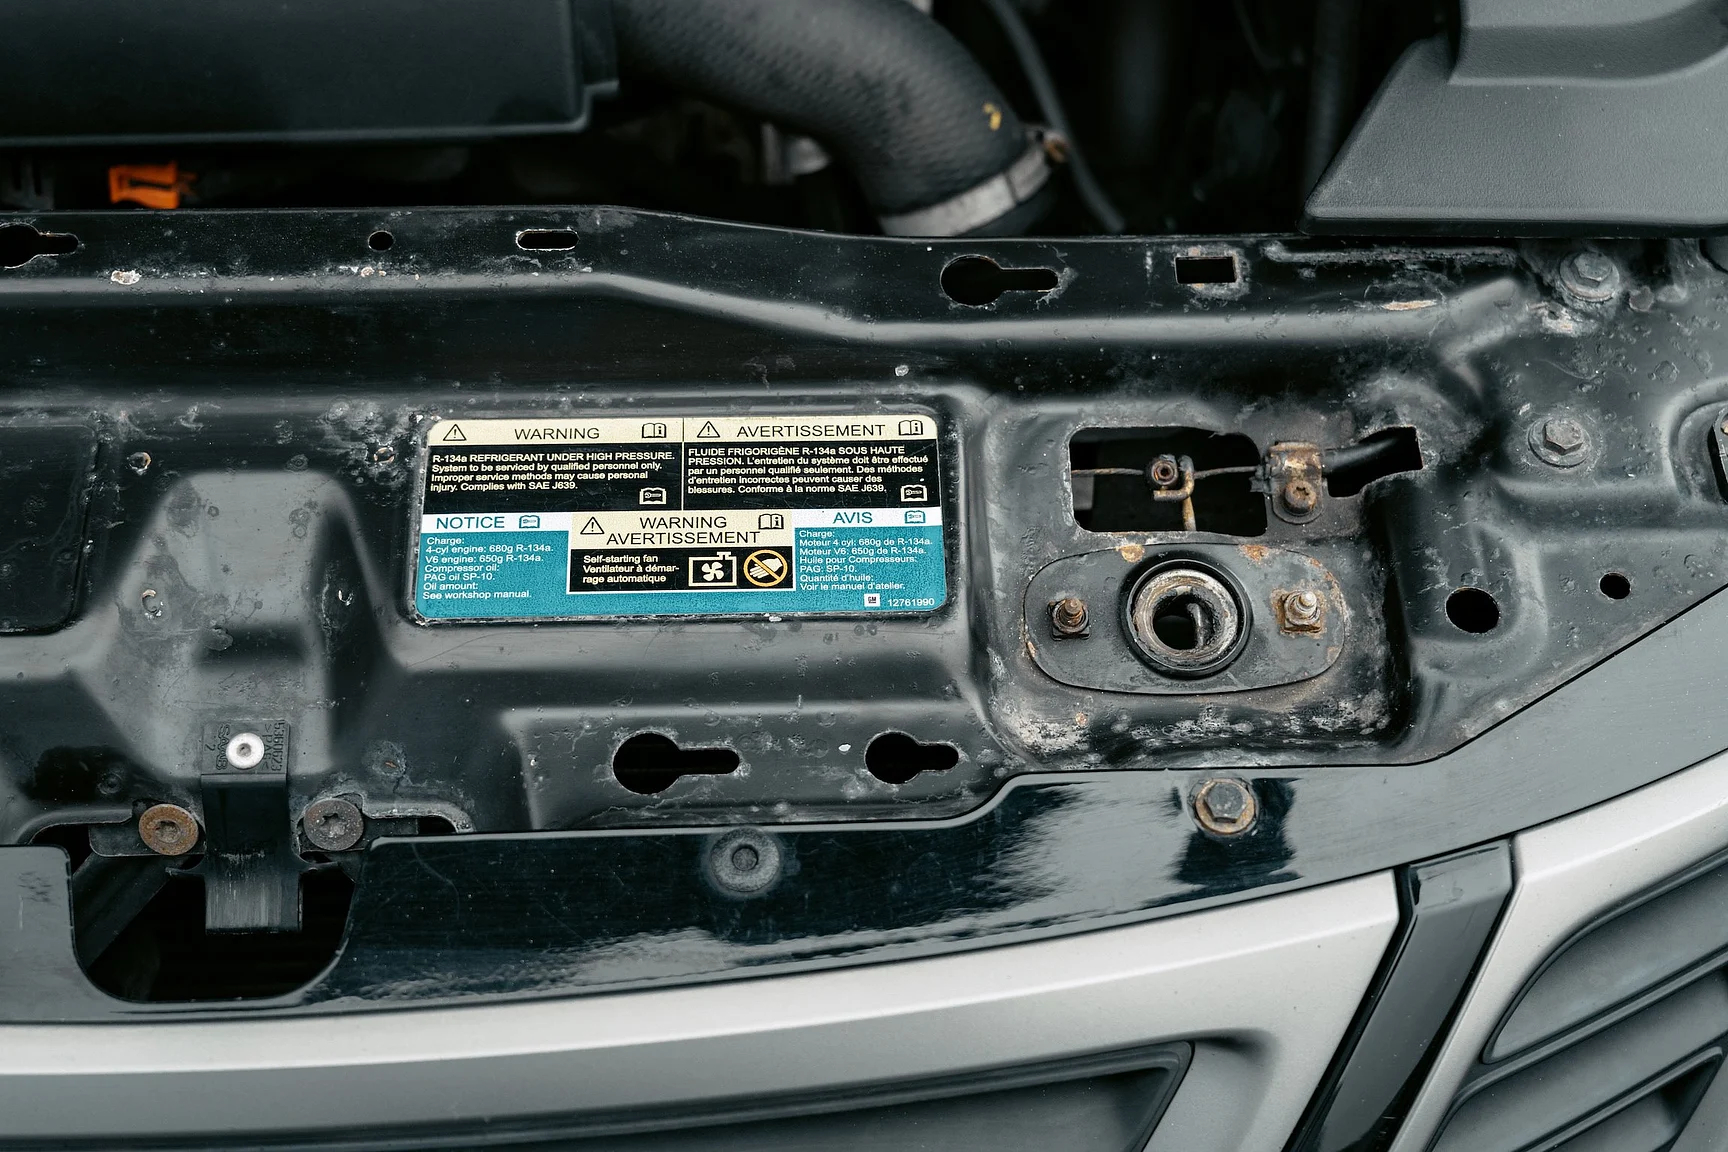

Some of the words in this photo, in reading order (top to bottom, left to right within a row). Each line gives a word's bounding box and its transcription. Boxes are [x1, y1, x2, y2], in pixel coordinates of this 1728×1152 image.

[515, 428, 600, 440] WARNING
[737, 425, 885, 437] AVERTISSEMENT
[689, 448, 726, 457] FLUIDE
[728, 446, 800, 456] FRIGORIGÈNE
[802, 447, 836, 455] R-134a
[838, 446, 868, 454] SOUS
[870, 446, 905, 454] HAUTE
[433, 454, 467, 463] R-134a
[470, 453, 544, 462] REFRIGERANT
[547, 453, 584, 461] UNDER
[586, 452, 612, 460] HIGH
[615, 452, 675, 460] PRESSURE.
[688, 457, 745, 466] PRESSION.
[747, 456, 794, 465] L'entretien
[797, 456, 808, 464] du
[811, 456, 850, 466] système
[852, 456, 869, 464] doit
[872, 455, 889, 464] être
[892, 455, 928, 463] effectué
[432, 464, 467, 473] System
[480, 463, 493, 471] be
[495, 463, 534, 472] serviced
[537, 462, 549, 472] by
[551, 462, 590, 472] qualified
[592, 461, 639, 471] personnel
[641, 461, 662, 471] only.
[688, 468, 704, 476] par
[705, 467, 718, 475] un
[720, 466, 766, 476] personnel
[768, 465, 801, 475] qualifié
[803, 465, 854, 474] seulement.
[857, 465, 876, 473] Des
[878, 464, 923, 473] méthodes
[431, 474, 473, 482] Improper
[512, 472, 552, 480] methods
[555, 472, 574, 482] may
[577, 472, 605, 480] cause
[608, 471, 648, 480] personal
[688, 475, 736, 484] d'entretien
[739, 475, 790, 483] incorrectes
[792, 475, 829, 485] peuvent
[865, 474, 882, 482] des
[431, 483, 458, 492] injury.
[461, 482, 504, 491] Complies
[506, 482, 526, 490] with
[528, 482, 550, 490] SAE
[552, 481, 578, 489] J639.
[688, 485, 735, 494] blessures.
[738, 484, 784, 493] Conforme
[786, 484, 792, 493] à
[795, 484, 803, 492] la
[838, 484, 859, 492] SAE
[861, 483, 887, 492] J639.
[833, 512, 873, 523] AVIS
[436, 517, 505, 529] NOTICE
[640, 517, 727, 529] WARNING
[606, 532, 760, 545] AVERTISSEMENT
[799, 530, 835, 539] Charge:
[427, 536, 464, 546] Charge:
[800, 538, 831, 547] Moteur
[833, 538, 838, 546] 4
[841, 538, 857, 547] cyl:
[859, 538, 881, 547] 680g
[898, 537, 932, 545] R-134a.
[426, 545, 449, 555] 4-cyl
[452, 545, 487, 554] engine:
[489, 545, 513, 554] 680g
[516, 544, 554, 552] R-134a.
[800, 548, 831, 556] Moteur
[851, 547, 874, 556] 650g
[441, 555, 476, 564] engine:
[479, 554, 503, 563] 650g
[506, 554, 543, 562] R-134a.
[583, 555, 641, 564] Self-starting
[643, 555, 658, 563] fan
[800, 556, 823, 564] Huile
[826, 557, 846, 565] pour
[848, 555, 917, 564] Compresseurs:
[425, 564, 482, 574] Compressor
[486, 564, 499, 572] oil:
[583, 565, 634, 573] Ventilateur
[636, 564, 643, 573] à
[645, 564, 679, 572] démar-
[800, 565, 824, 573] PAG:
[826, 564, 857, 572] SP-10.
[424, 574, 446, 582] PAG
[463, 573, 495, 581] SP-10.
[583, 576, 604, 584] rage
[607, 574, 666, 584] automatique
[800, 573, 839, 583] Quantité
[841, 574, 874, 582] d'huile:
[424, 583, 437, 591] Oil
[439, 583, 478, 591] amount:
[821, 582, 829, 590] le
[831, 582, 865, 590] manuel
[423, 592, 442, 600] See
[445, 591, 491, 600] workshop
[494, 590, 531, 598] manual.
[888, 598, 935, 606] 12761990
[216, 724, 230, 770] SAAB
